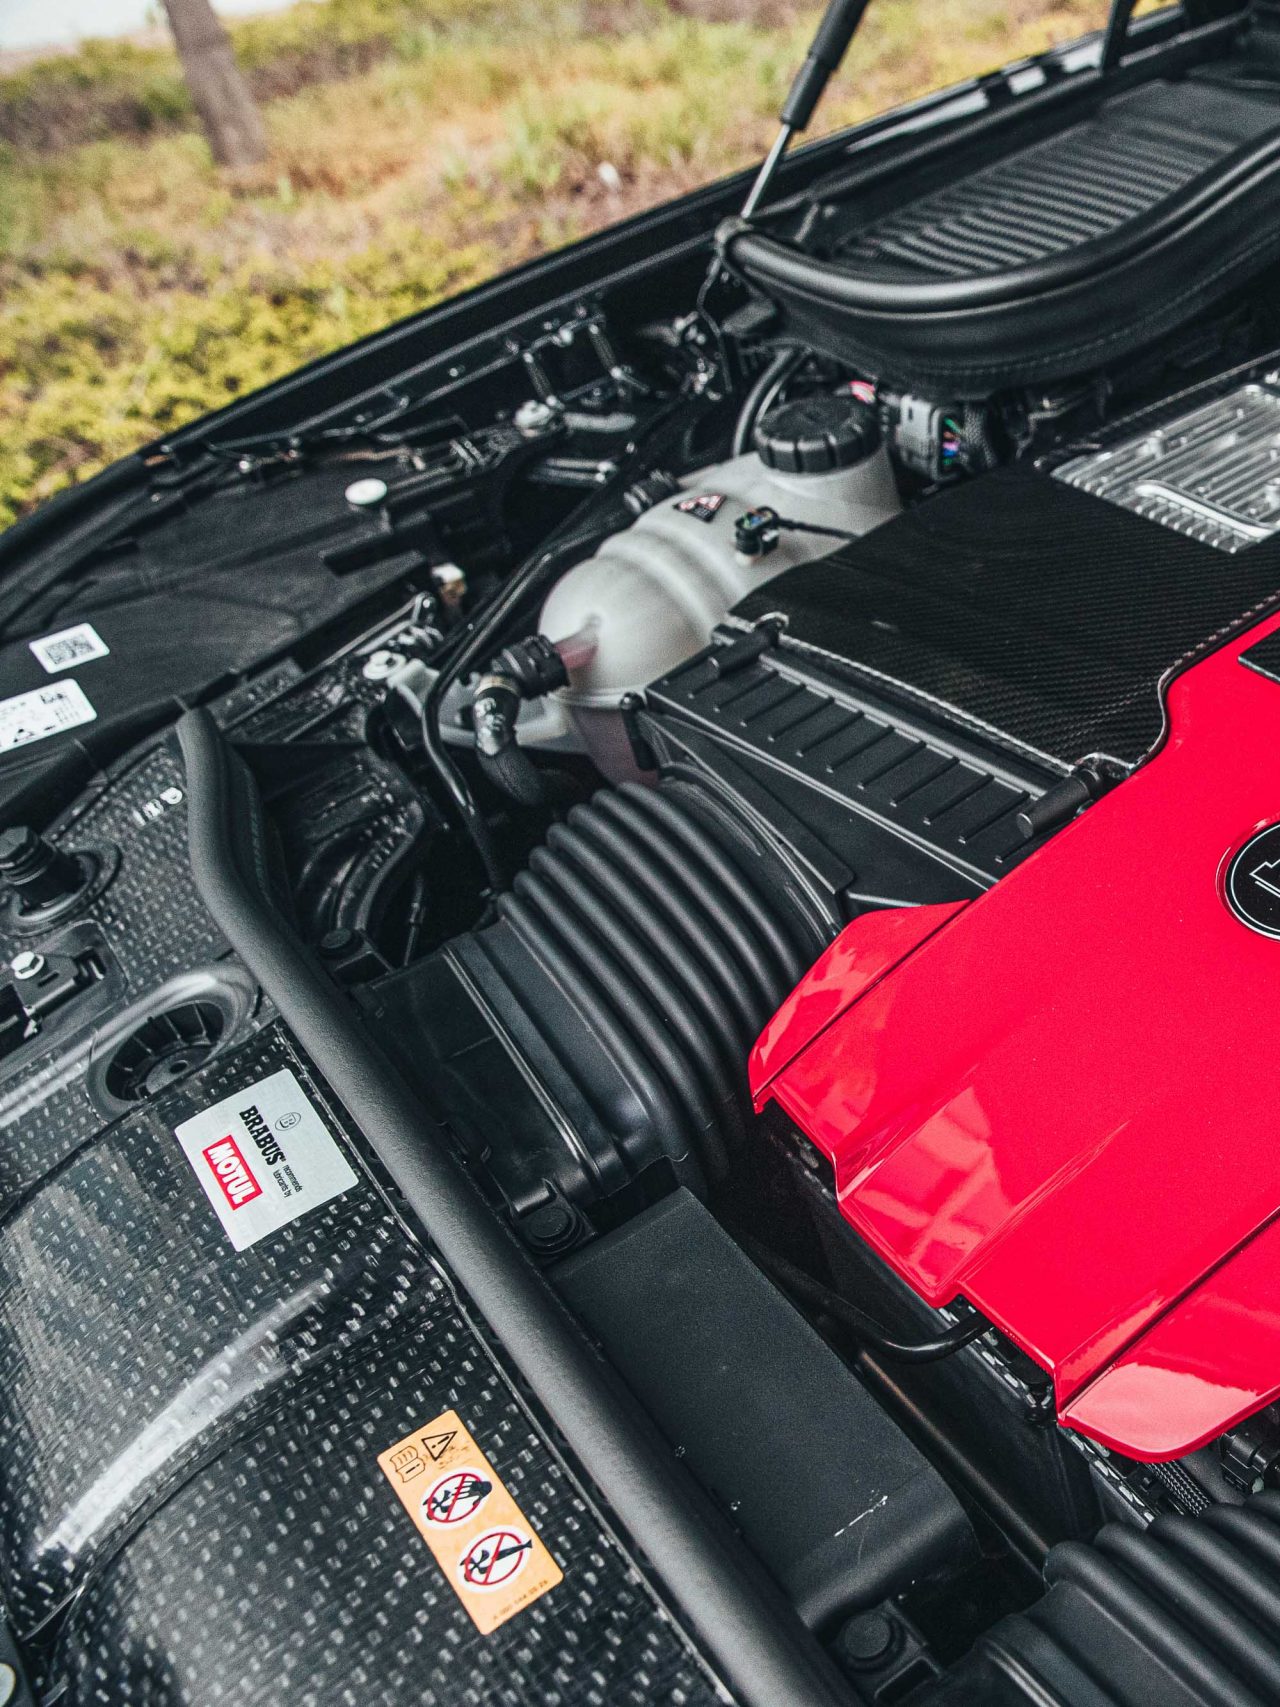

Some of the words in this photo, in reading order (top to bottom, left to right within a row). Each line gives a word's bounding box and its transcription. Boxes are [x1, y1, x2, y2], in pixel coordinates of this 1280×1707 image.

[207, 1142, 256, 1205] MOTUL
[272, 1170, 289, 1191] lubricants
[282, 1164, 303, 1193] recommends
